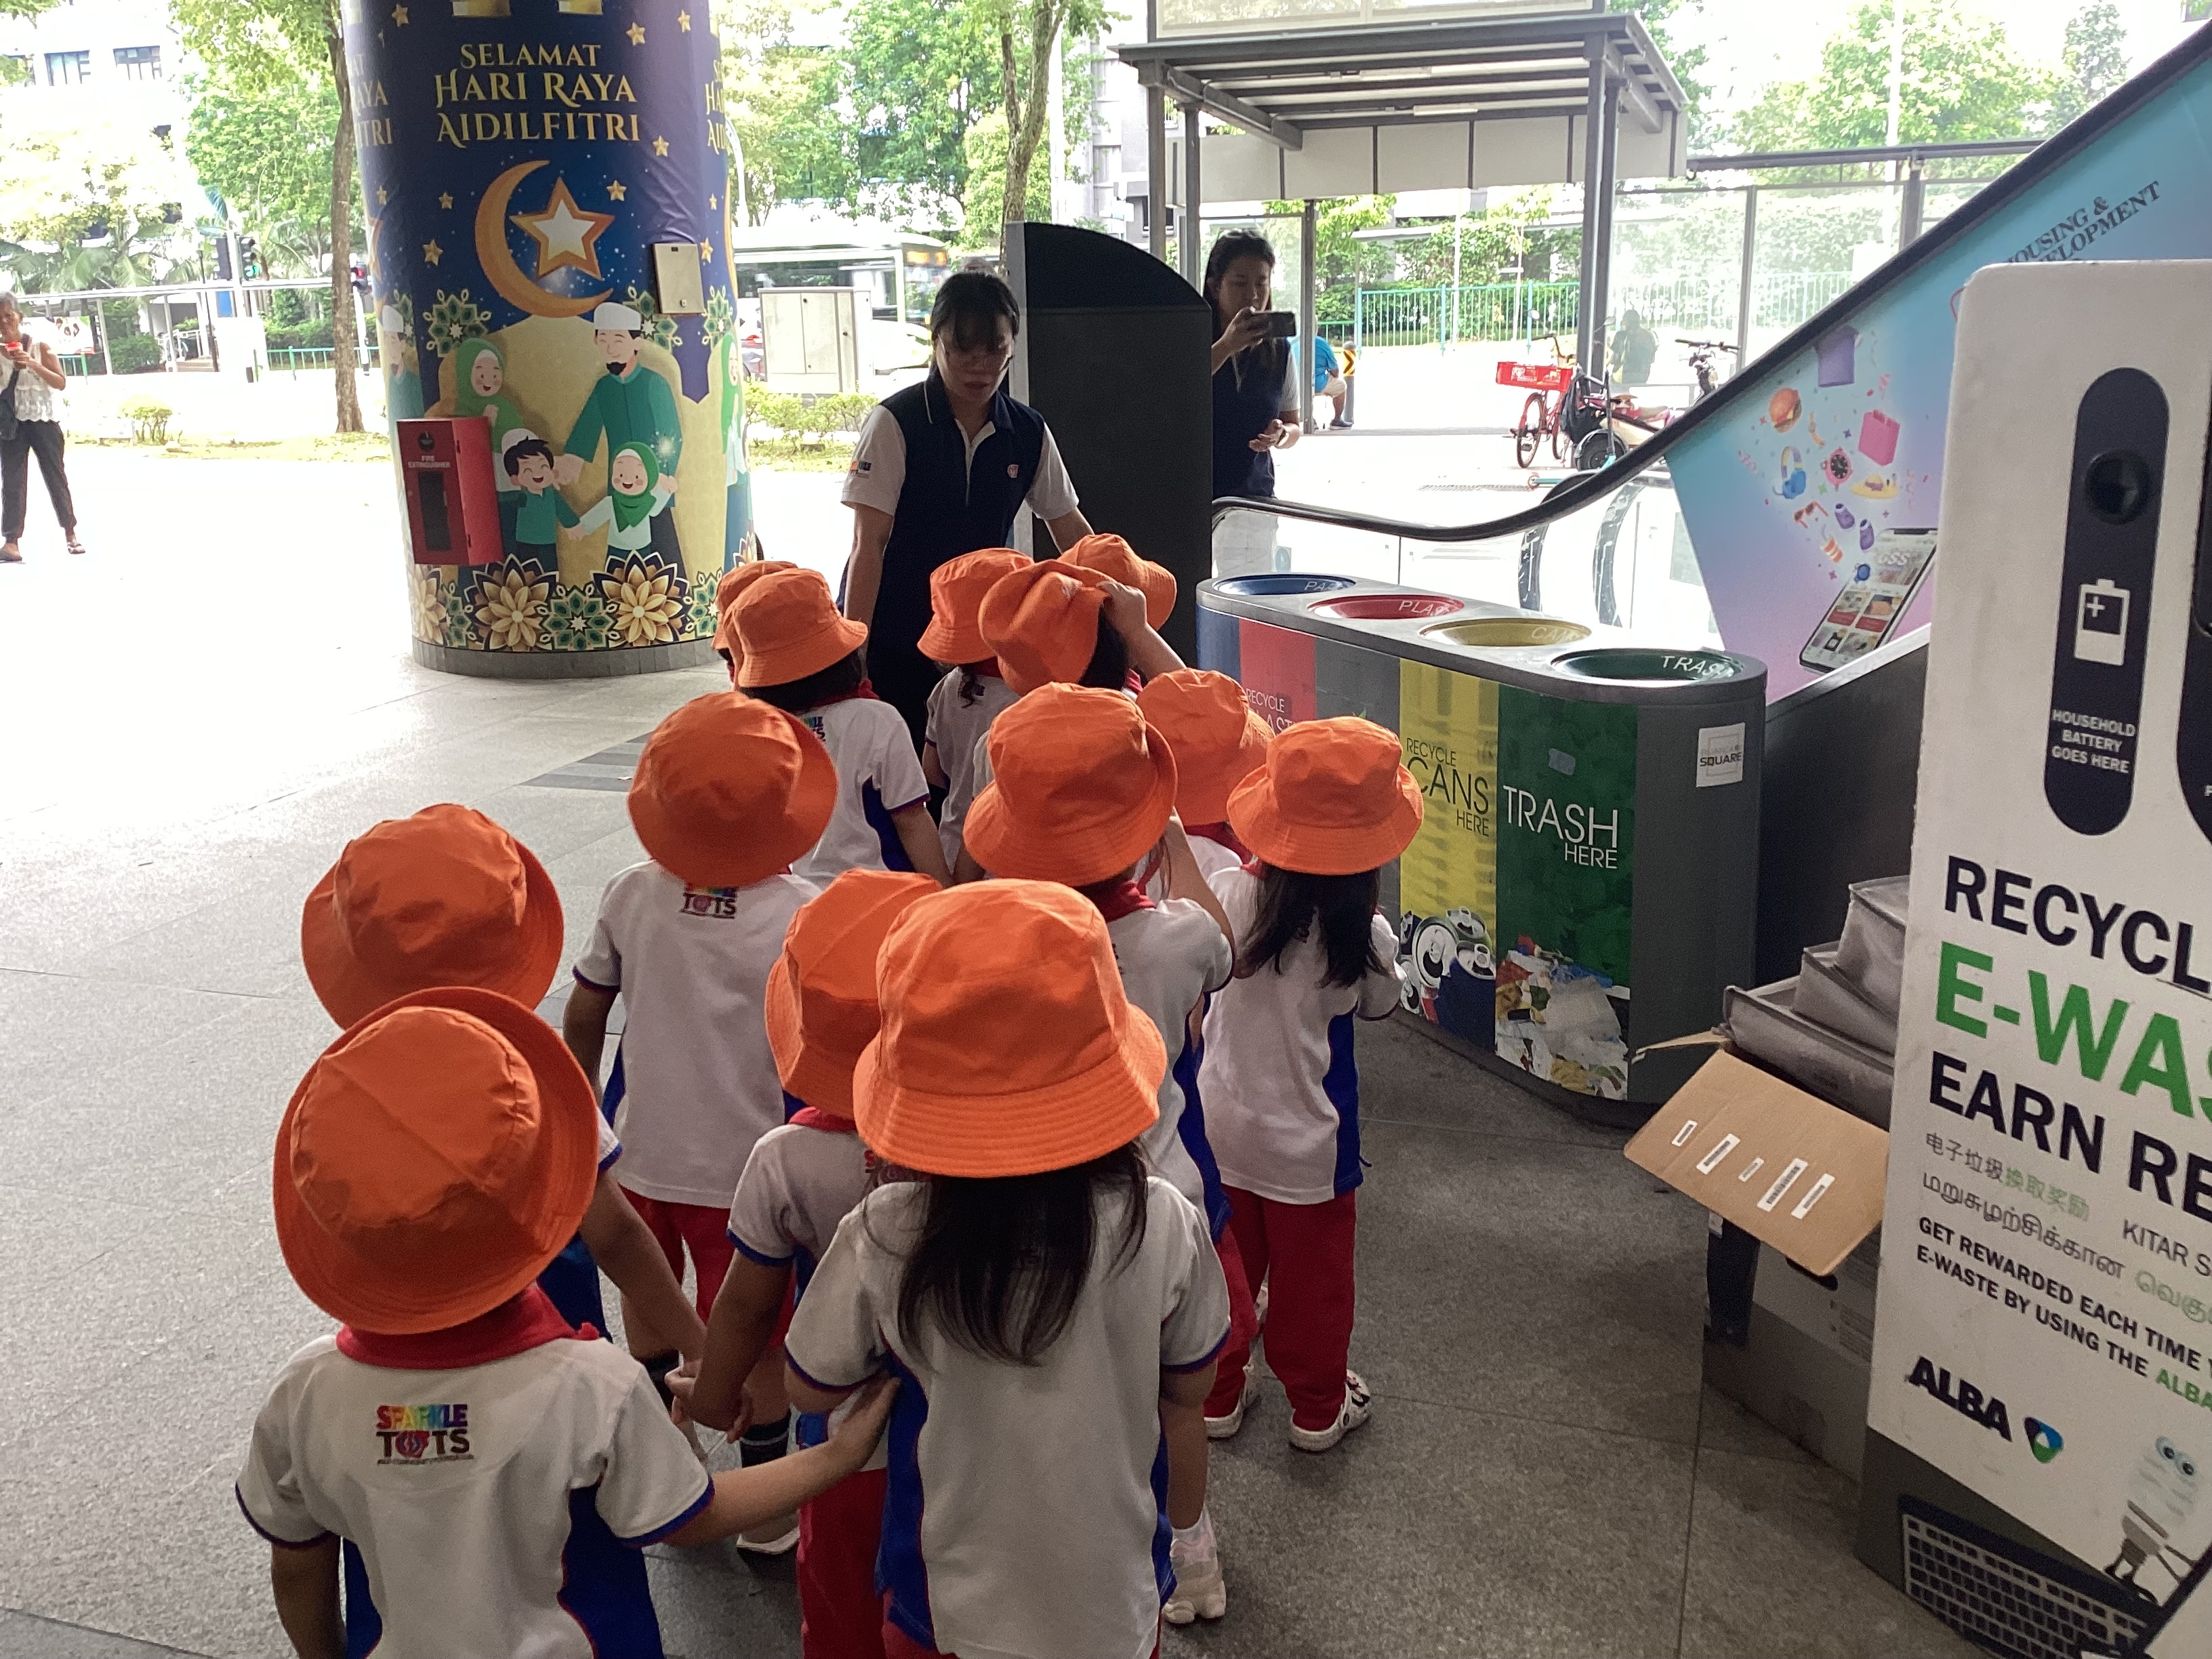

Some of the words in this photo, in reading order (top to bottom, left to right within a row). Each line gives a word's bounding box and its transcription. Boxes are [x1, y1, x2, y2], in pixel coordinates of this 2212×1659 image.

[461, 43, 601, 68] SELAMAT
[434, 68, 527, 108] HARI
[544, 73, 637, 108] RAYA
[437, 112, 641, 148] AIDILFITRI
[2093, 196, 2109, 216] &
[1246, 688, 1285, 714] RECYCLE
[2052, 709, 2135, 737] HOUSEHOLD
[1406, 737, 1456, 767] RECYCLE
[2062, 729, 2123, 752] BATTERY
[1700, 752, 1742, 766] SQUARE
[2051, 745, 2087, 764] GOES
[2091, 754, 2130, 773] HERE
[1457, 808, 1490, 837] HERE
[1502, 785, 1618, 848] TRASH
[1565, 842, 1618, 869] HERE
[1929, 1050, 2106, 1174] EARN
[2123, 1219, 2189, 1267] KITAR
[1919, 1216, 1955, 1246] GET
[1960, 1235, 2074, 1305] REWARDED
[2080, 1295, 2138, 1340] EACH
[2145, 1326, 2202, 1372] TIME
[1917, 1244, 1999, 1300] E-WASTE
[2004, 1288, 2031, 1314] BY
[2035, 1304, 2100, 1352] USING
[2106, 1340, 2149, 1378] THE
[1906, 1356, 2012, 1443] ALBA
